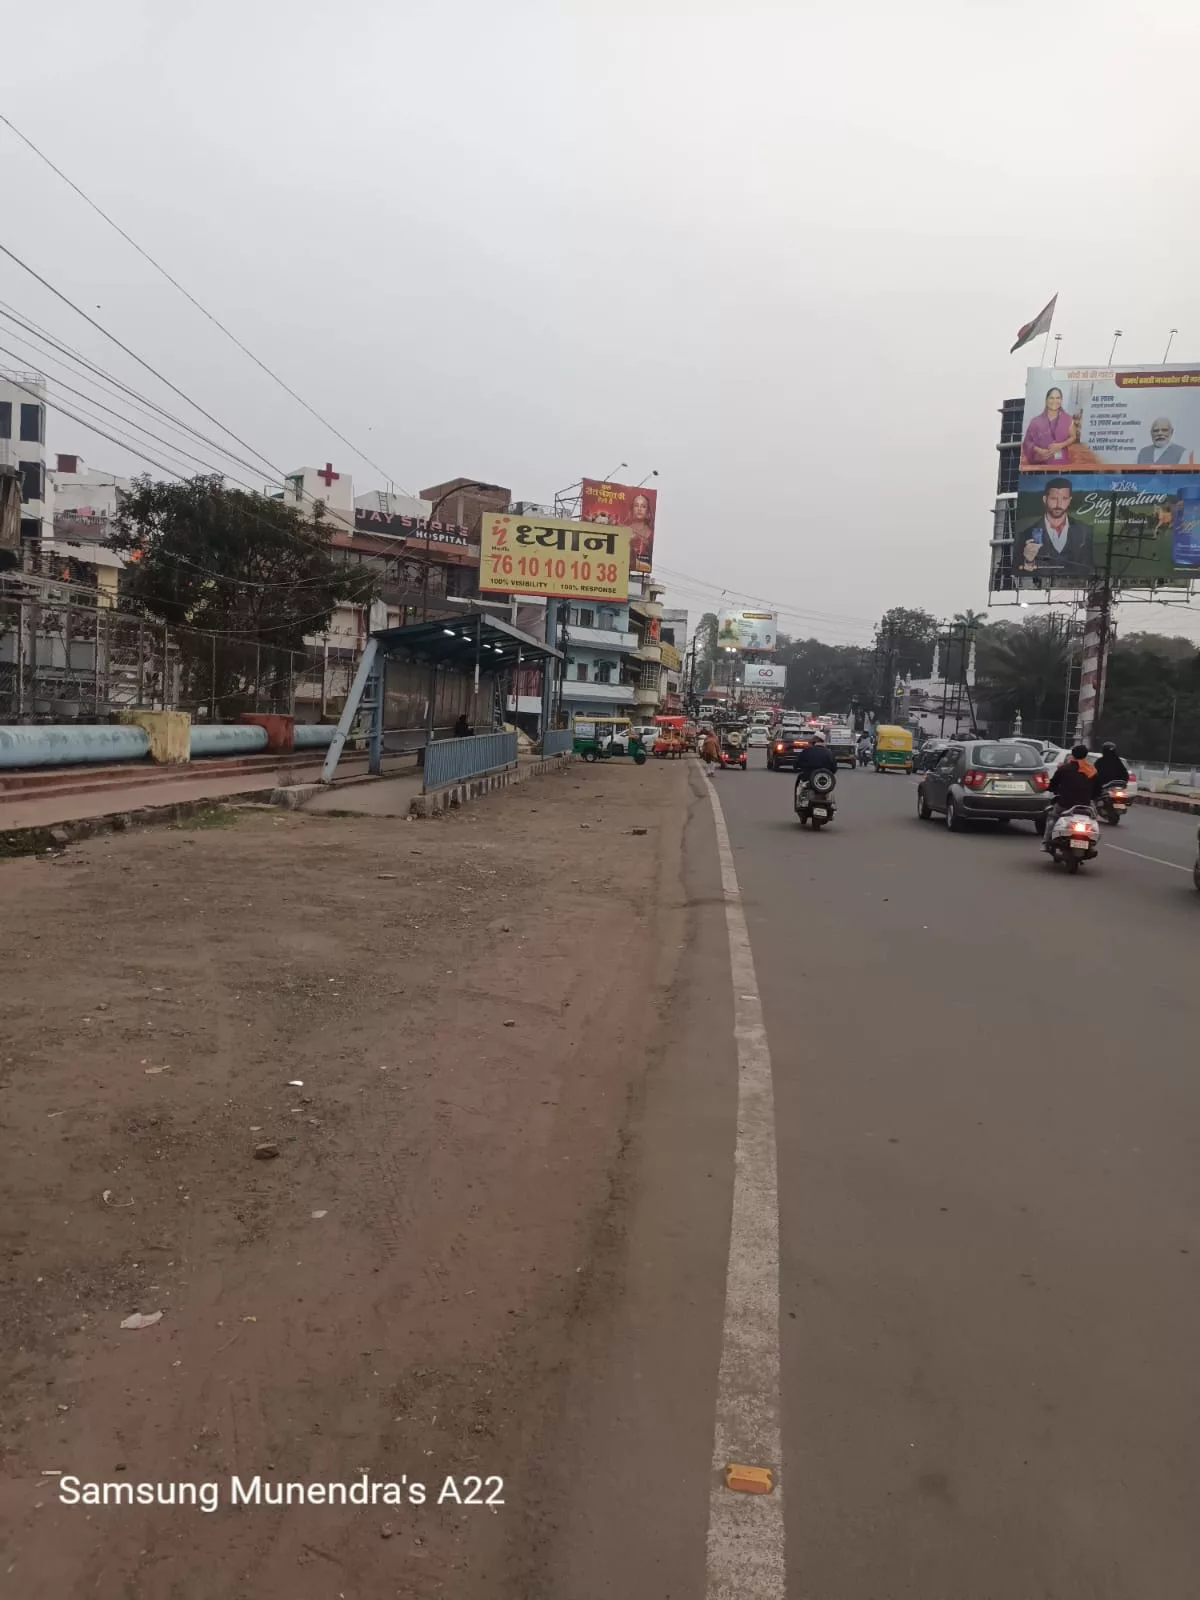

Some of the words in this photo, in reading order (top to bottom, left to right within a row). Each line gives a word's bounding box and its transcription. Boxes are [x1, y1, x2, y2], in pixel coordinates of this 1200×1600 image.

[1076, 489, 1168, 518] Signature
[356, 508, 394, 524] JAY
[400, 515, 470, 537] SHREE
[415, 530, 469, 546] HOSPITAL
[515, 524, 619, 555] ध्यान
[490, 553, 513, 575] 76
[518, 556, 539, 577] 10
[545, 558, 566, 579] 10
[570, 560, 591, 581] 10
[596, 562, 618, 583] 38
[490, 578, 509, 586] 100%
[510, 579, 548, 589] VISIBILITY
[560, 583, 579, 591] 100%
[580, 584, 617, 594] RESPONSE
